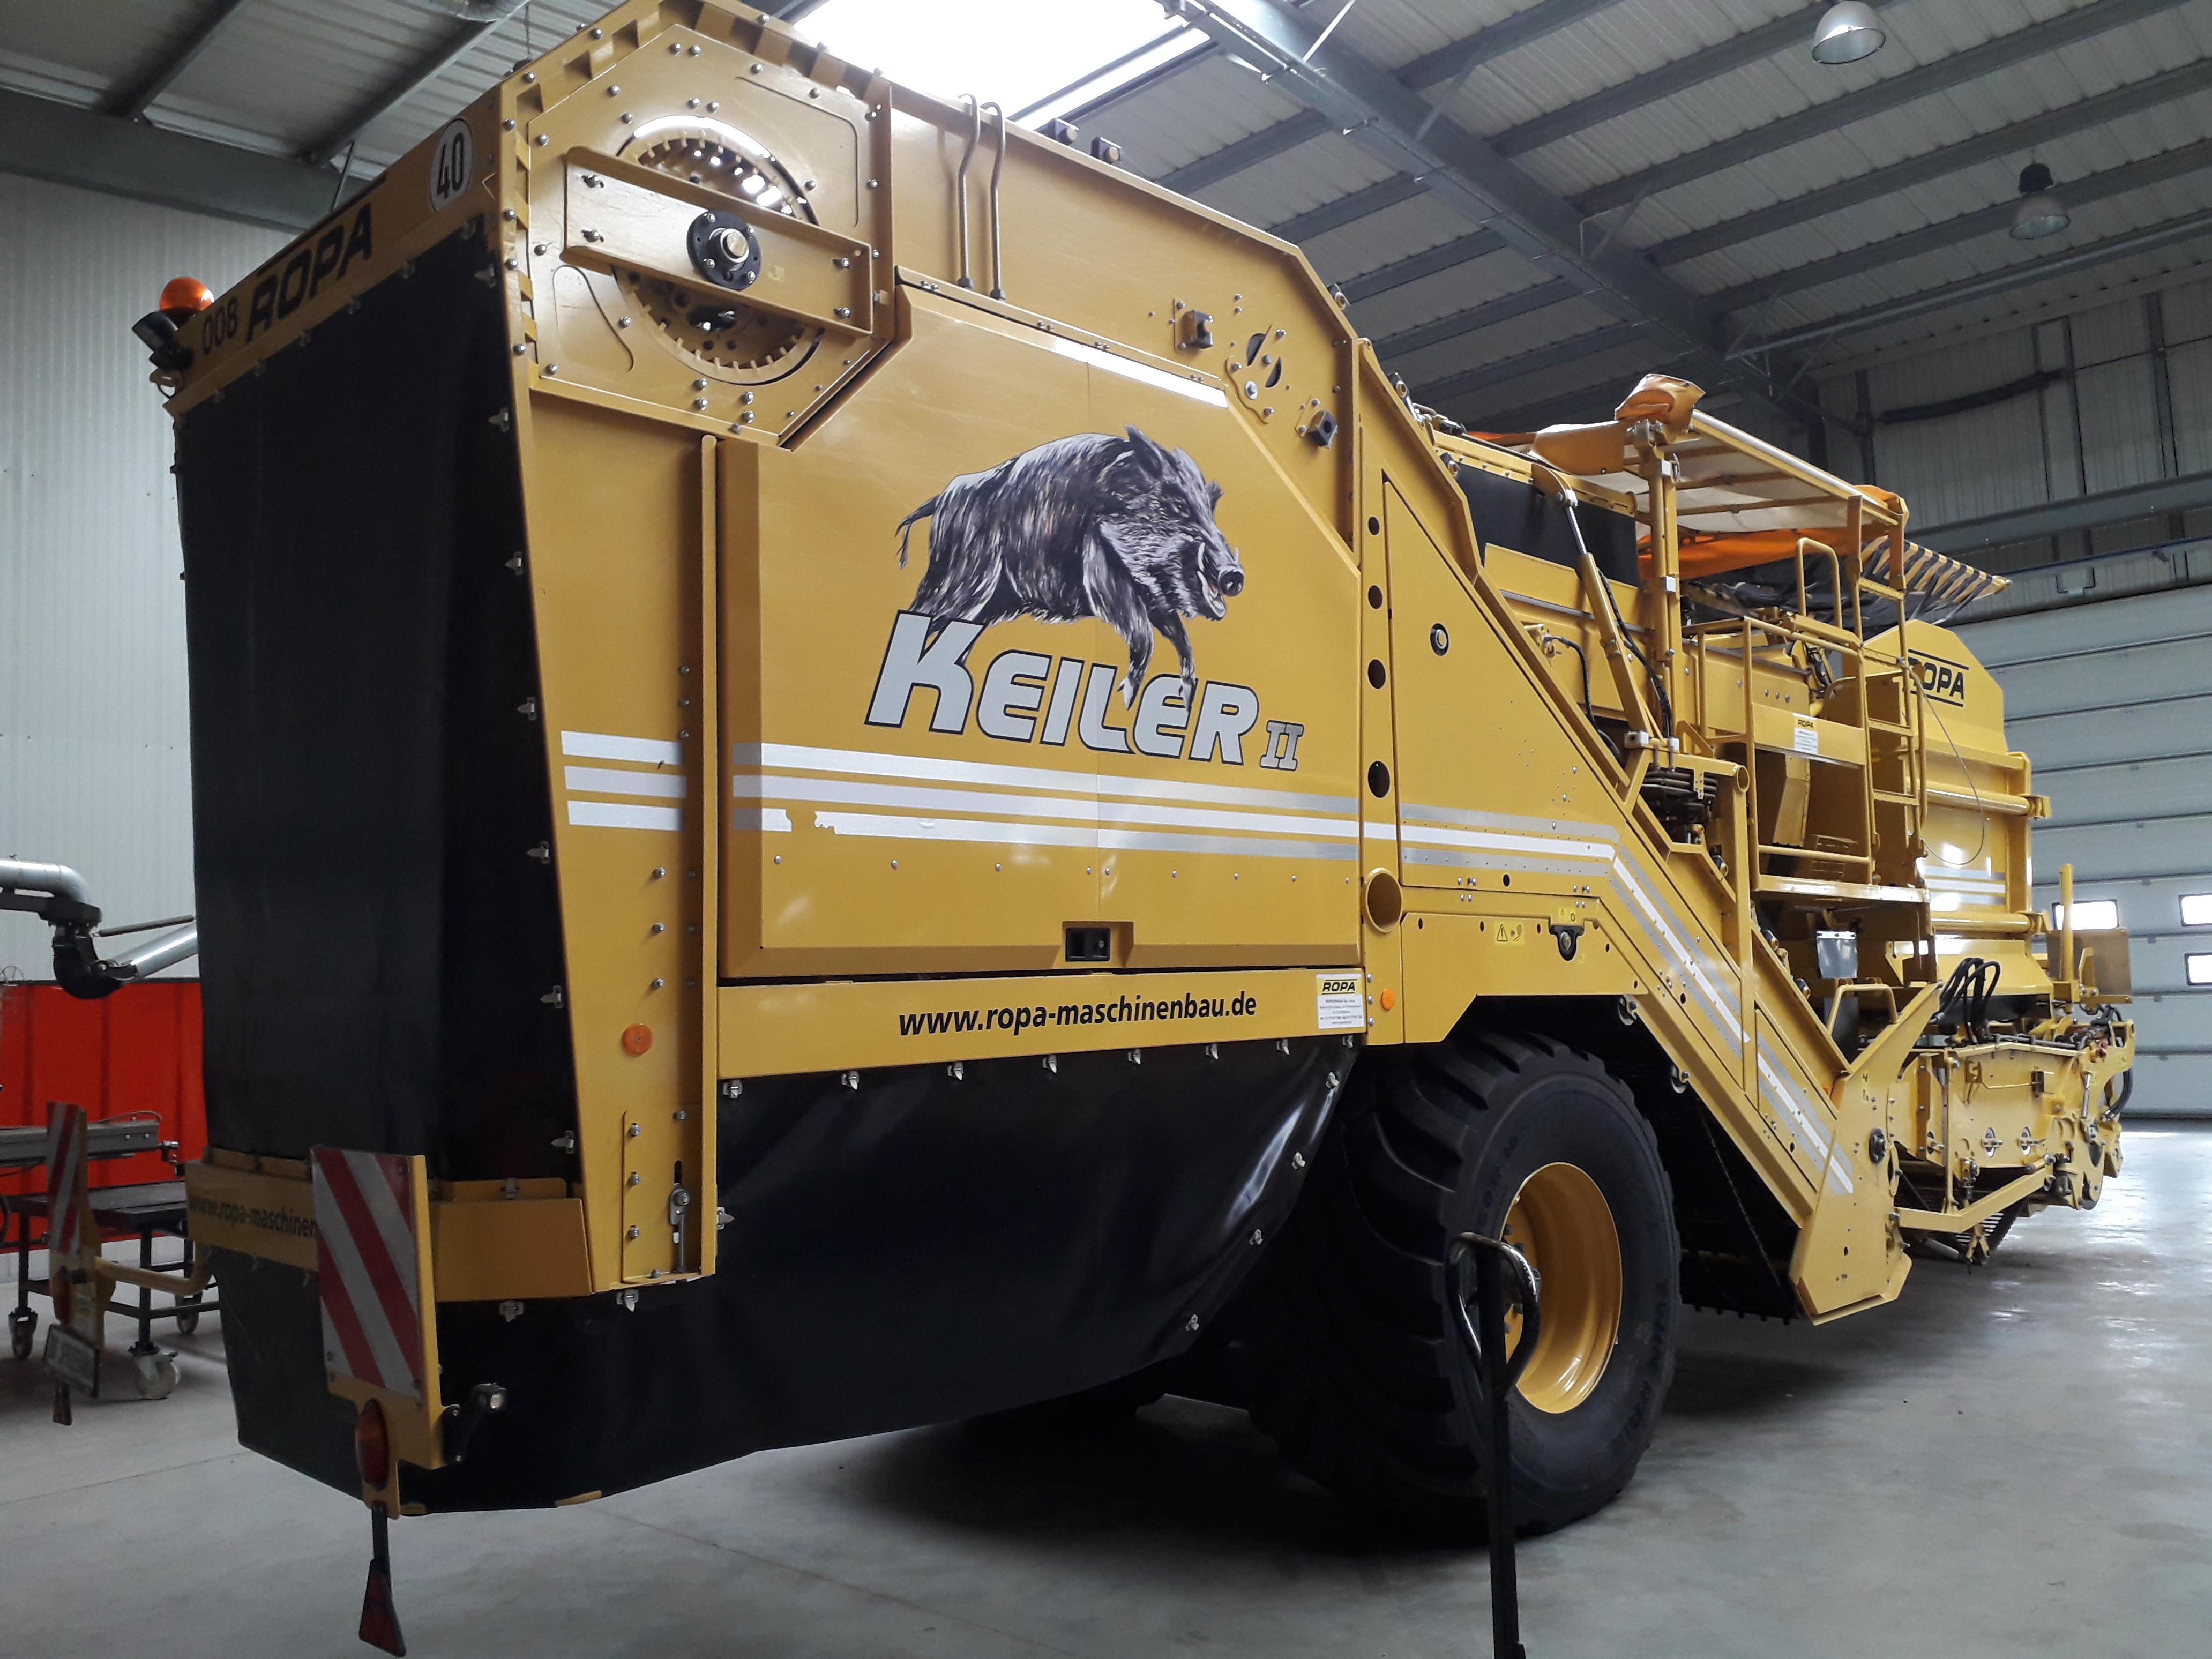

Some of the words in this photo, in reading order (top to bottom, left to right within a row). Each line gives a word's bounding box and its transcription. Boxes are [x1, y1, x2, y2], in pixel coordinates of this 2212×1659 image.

[436, 132, 465, 199] 40
[202, 296, 238, 355] 008
[246, 203, 372, 343] ROPA
[1259, 720, 1305, 771] II
[1797, 719, 1814, 728] ROPA
[1322, 981, 1355, 992] ROPA
[899, 990, 1257, 1036] www.ropa-maschinenbau.de
